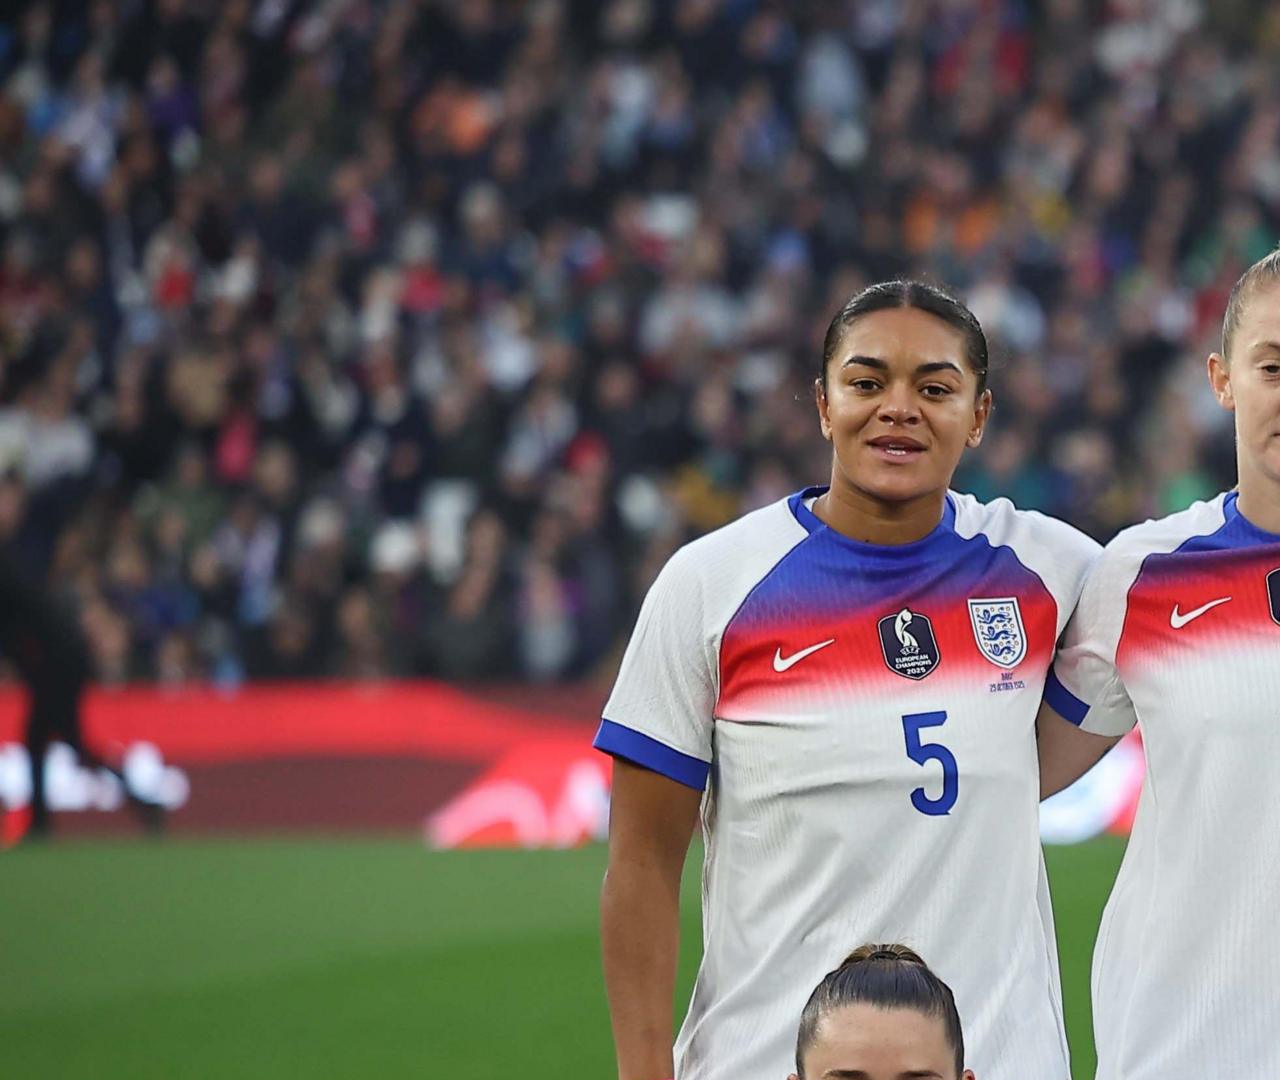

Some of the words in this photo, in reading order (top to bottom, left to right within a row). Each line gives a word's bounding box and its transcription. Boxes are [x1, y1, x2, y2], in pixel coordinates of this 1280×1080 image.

[896, 654, 928, 663] EUROPEAN
[896, 660, 931, 669] CHAMPIONS
[902, 711, 959, 816] 5
